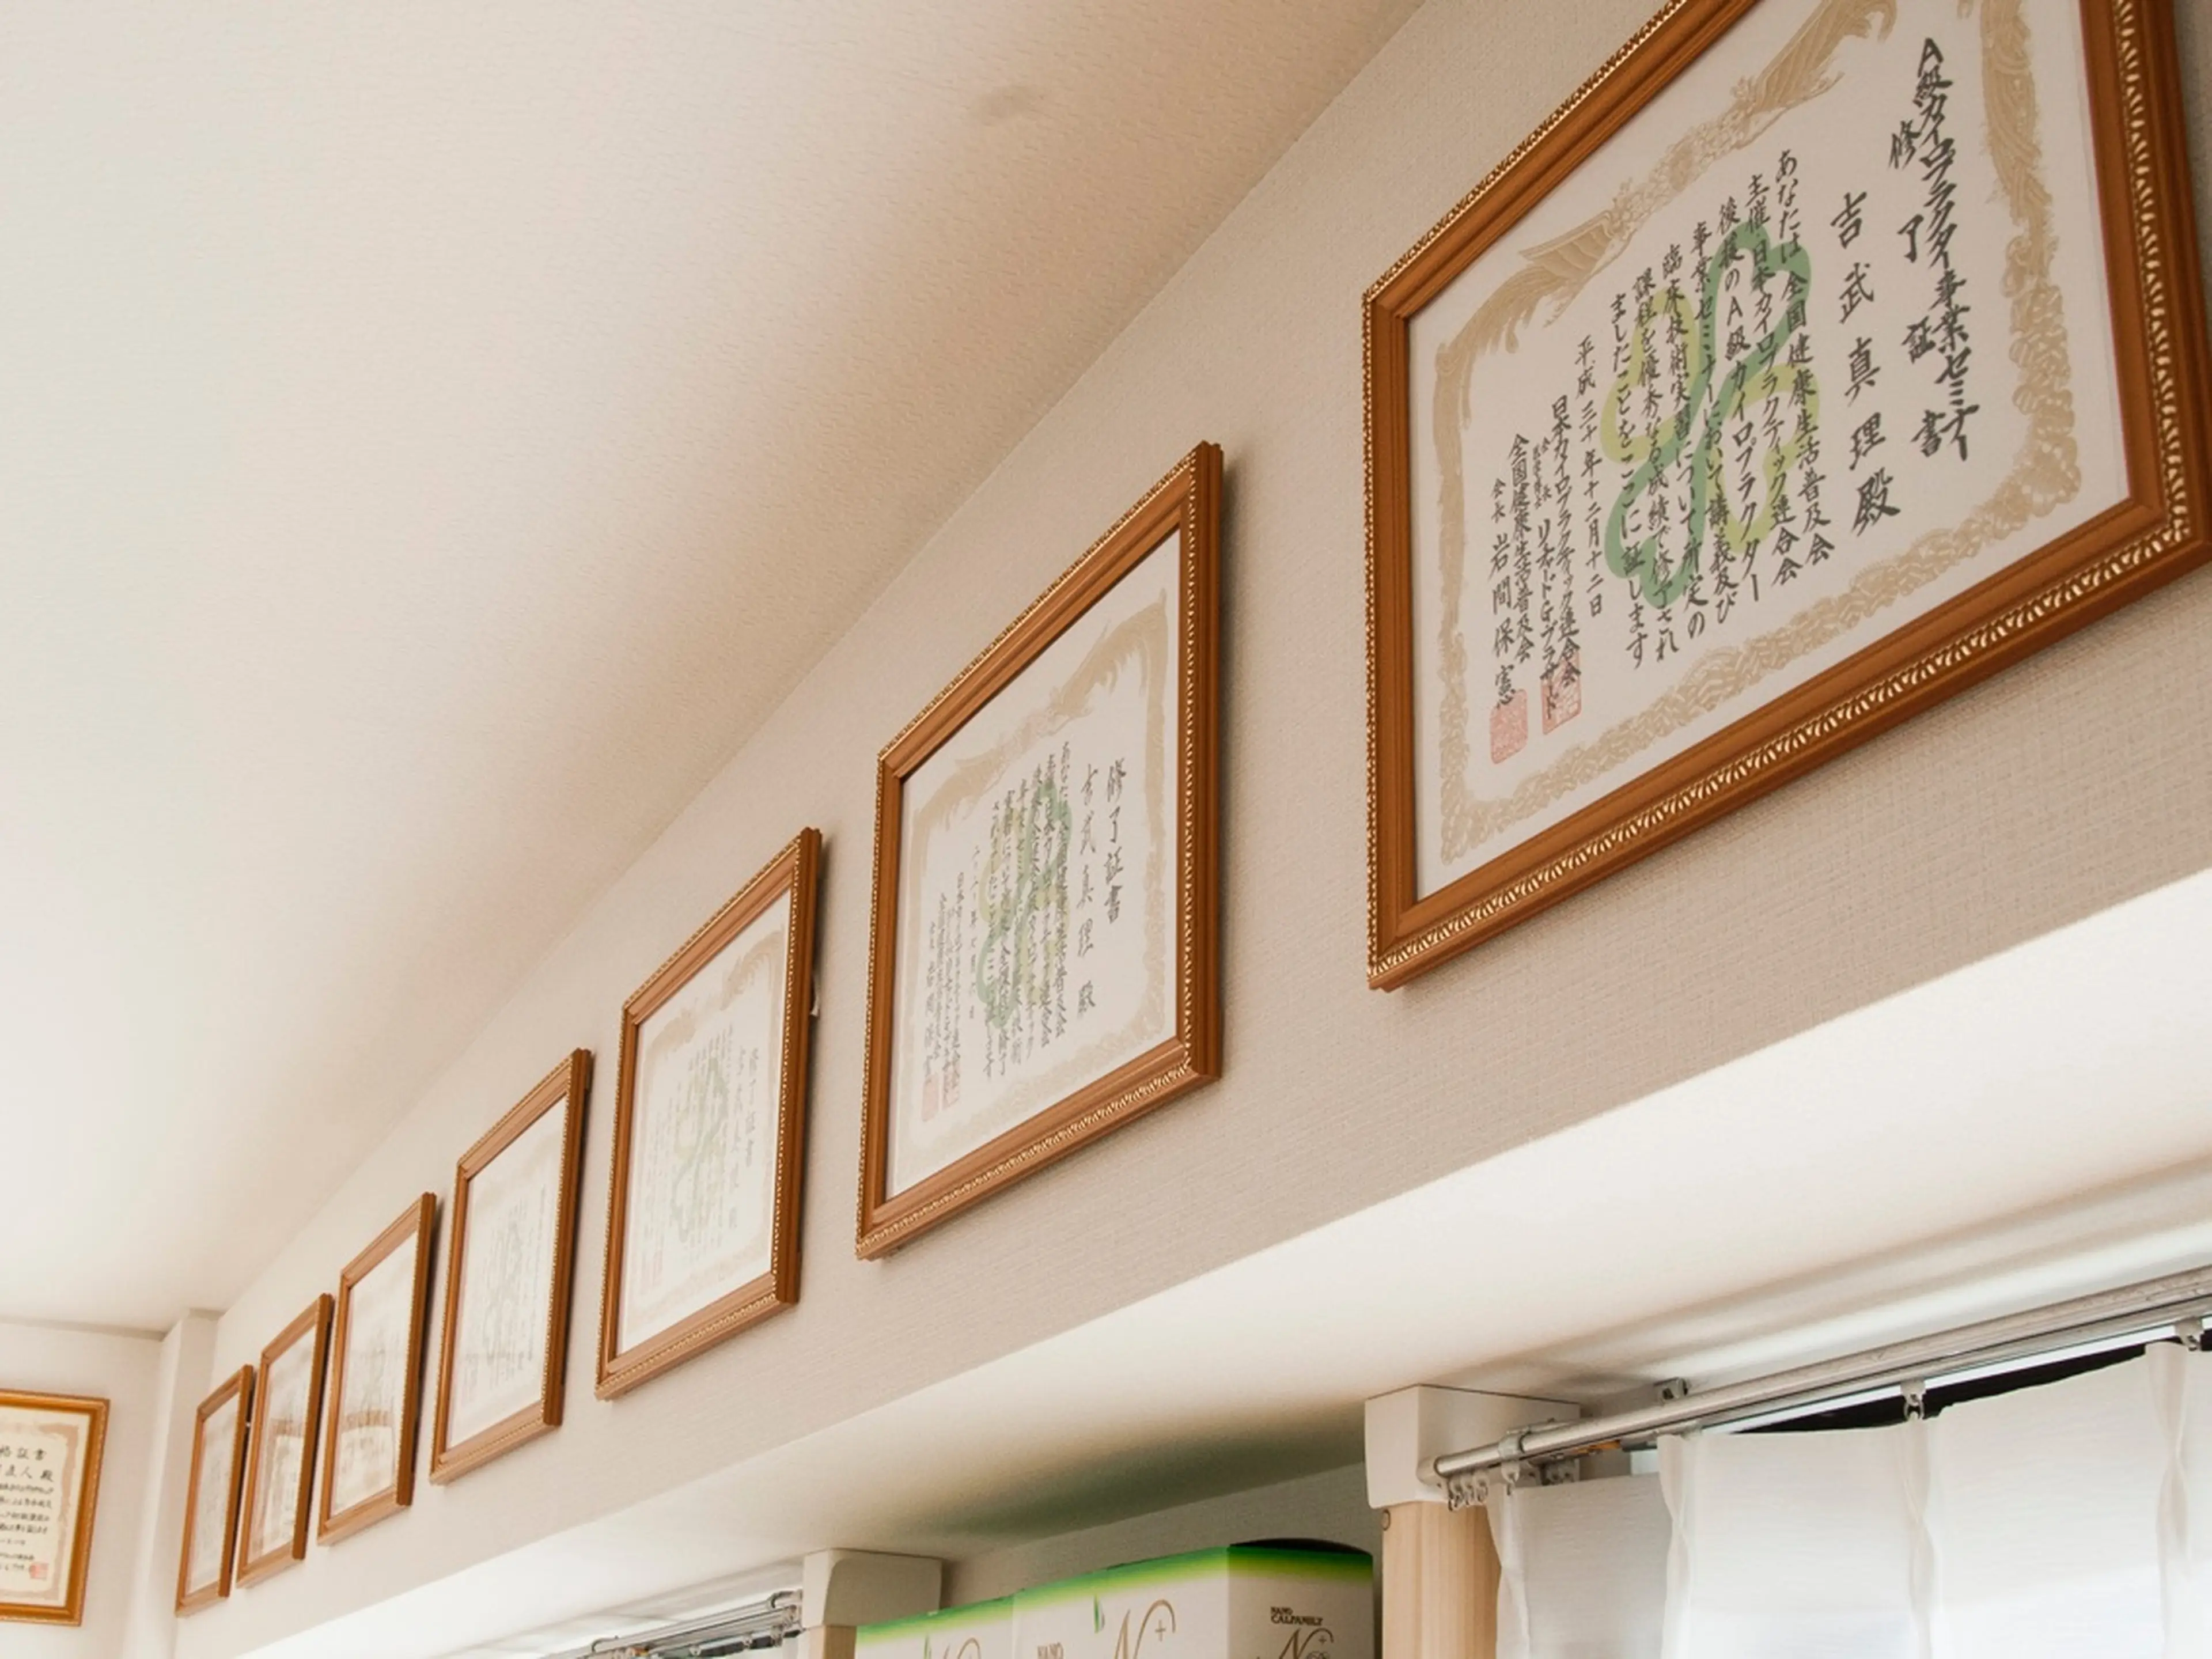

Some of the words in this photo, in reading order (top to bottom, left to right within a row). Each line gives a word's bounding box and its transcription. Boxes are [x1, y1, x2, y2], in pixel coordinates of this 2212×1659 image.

[1831, 192, 1902, 537] 吉武真理殿
[1889, 120, 1942, 458] 修了証書
[1104, 758, 1127, 925] 修了証書
